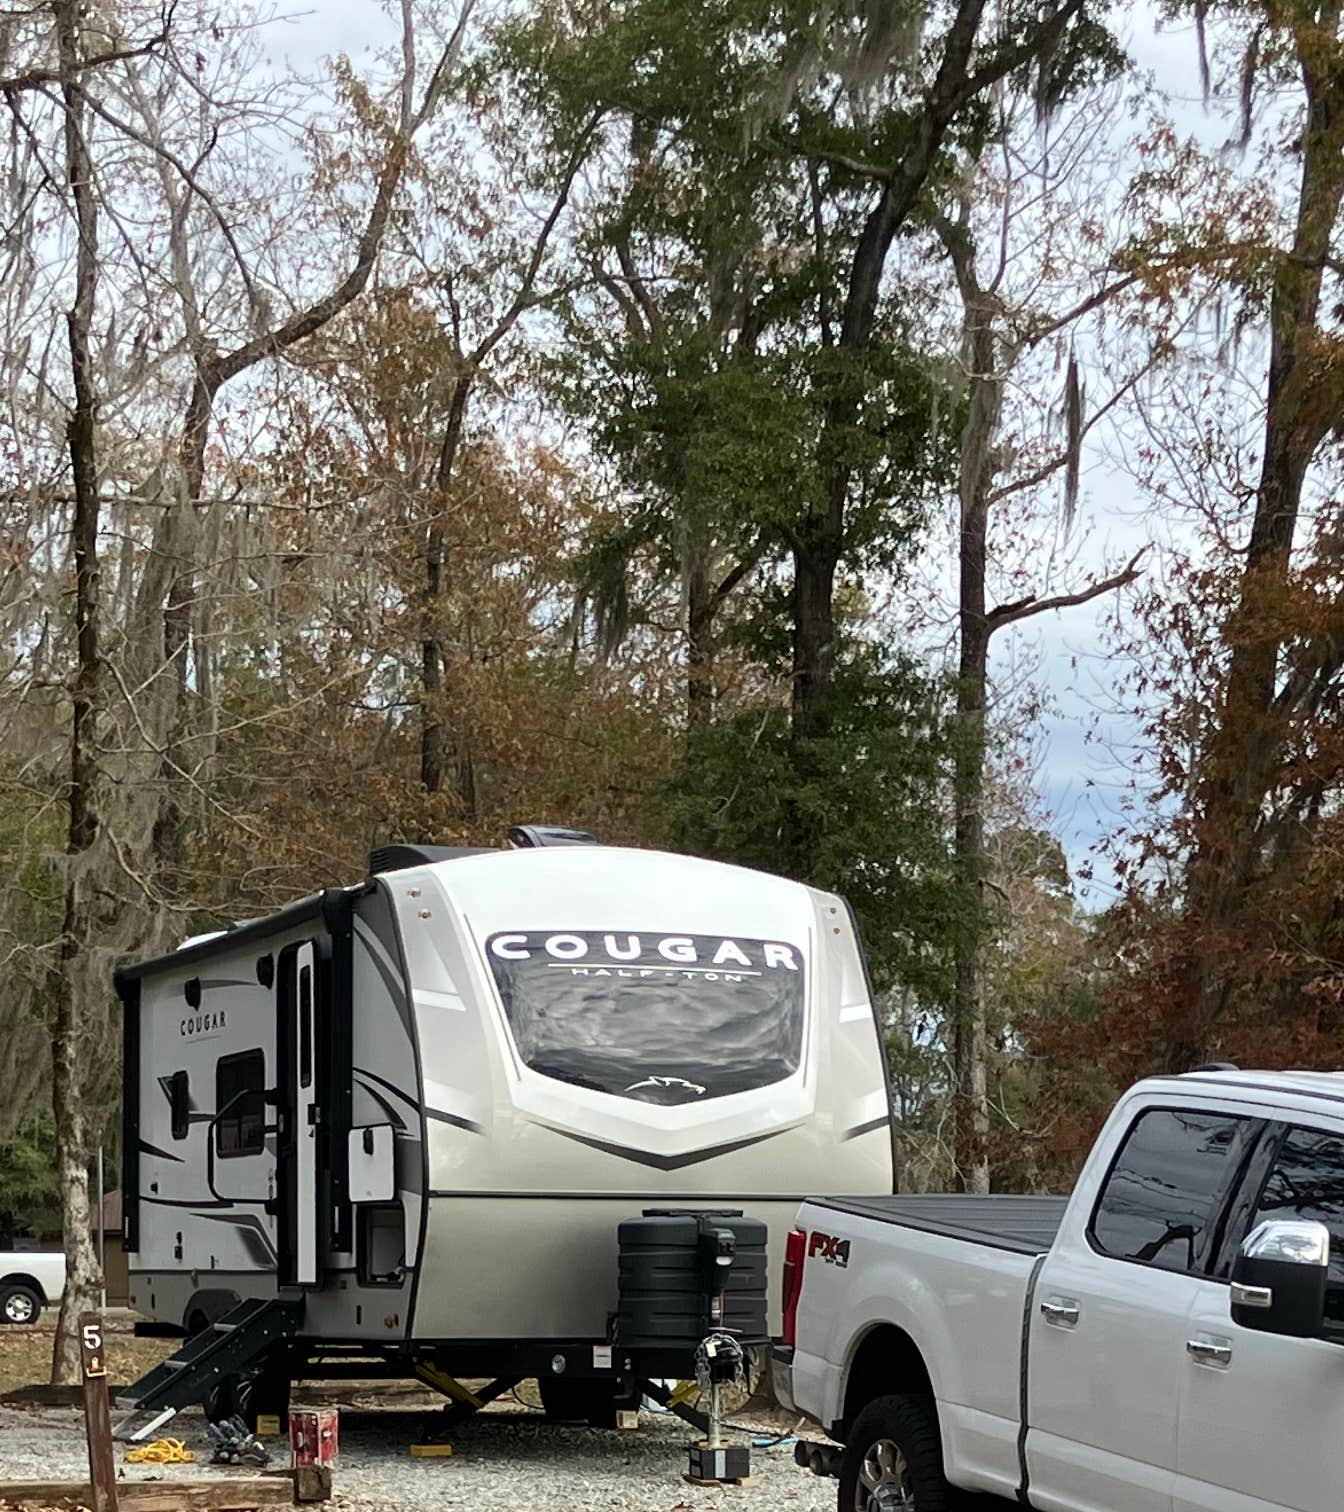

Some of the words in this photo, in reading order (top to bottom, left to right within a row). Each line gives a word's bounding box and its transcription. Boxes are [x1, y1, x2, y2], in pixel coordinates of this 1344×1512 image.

[490, 933, 799, 972] COUGAR
[570, 967, 743, 983] HALF-TON
[180, 1011, 226, 1036] COUGAR
[808, 1231, 851, 1263] FX4
[83, 1324, 102, 1350] 5
